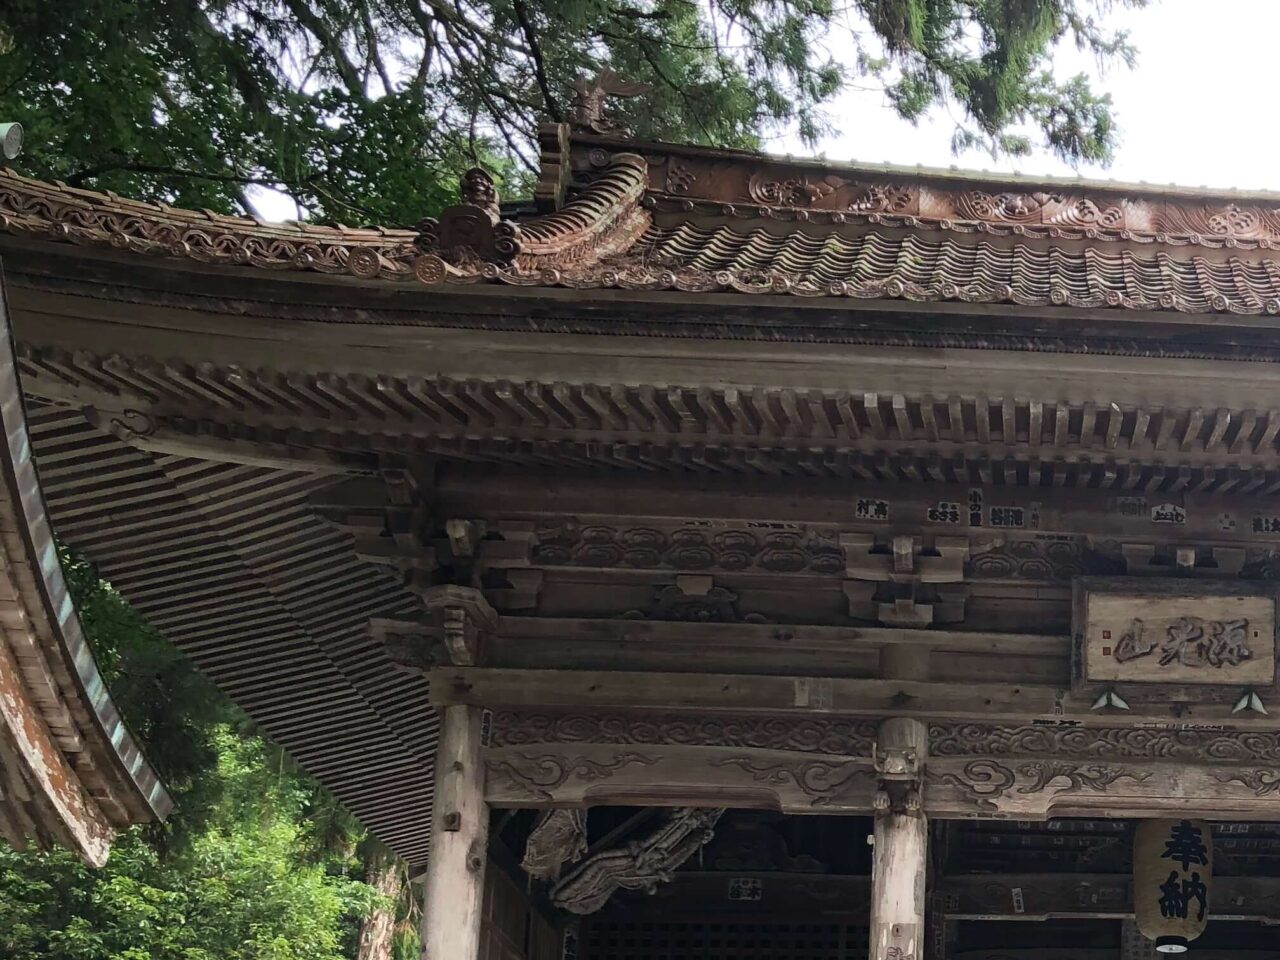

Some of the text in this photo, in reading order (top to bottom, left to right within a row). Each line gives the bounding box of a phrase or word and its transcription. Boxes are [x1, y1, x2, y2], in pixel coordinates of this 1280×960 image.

[1113, 615, 1253, 668] 源光山
[1158, 819, 1209, 922] 奉納
